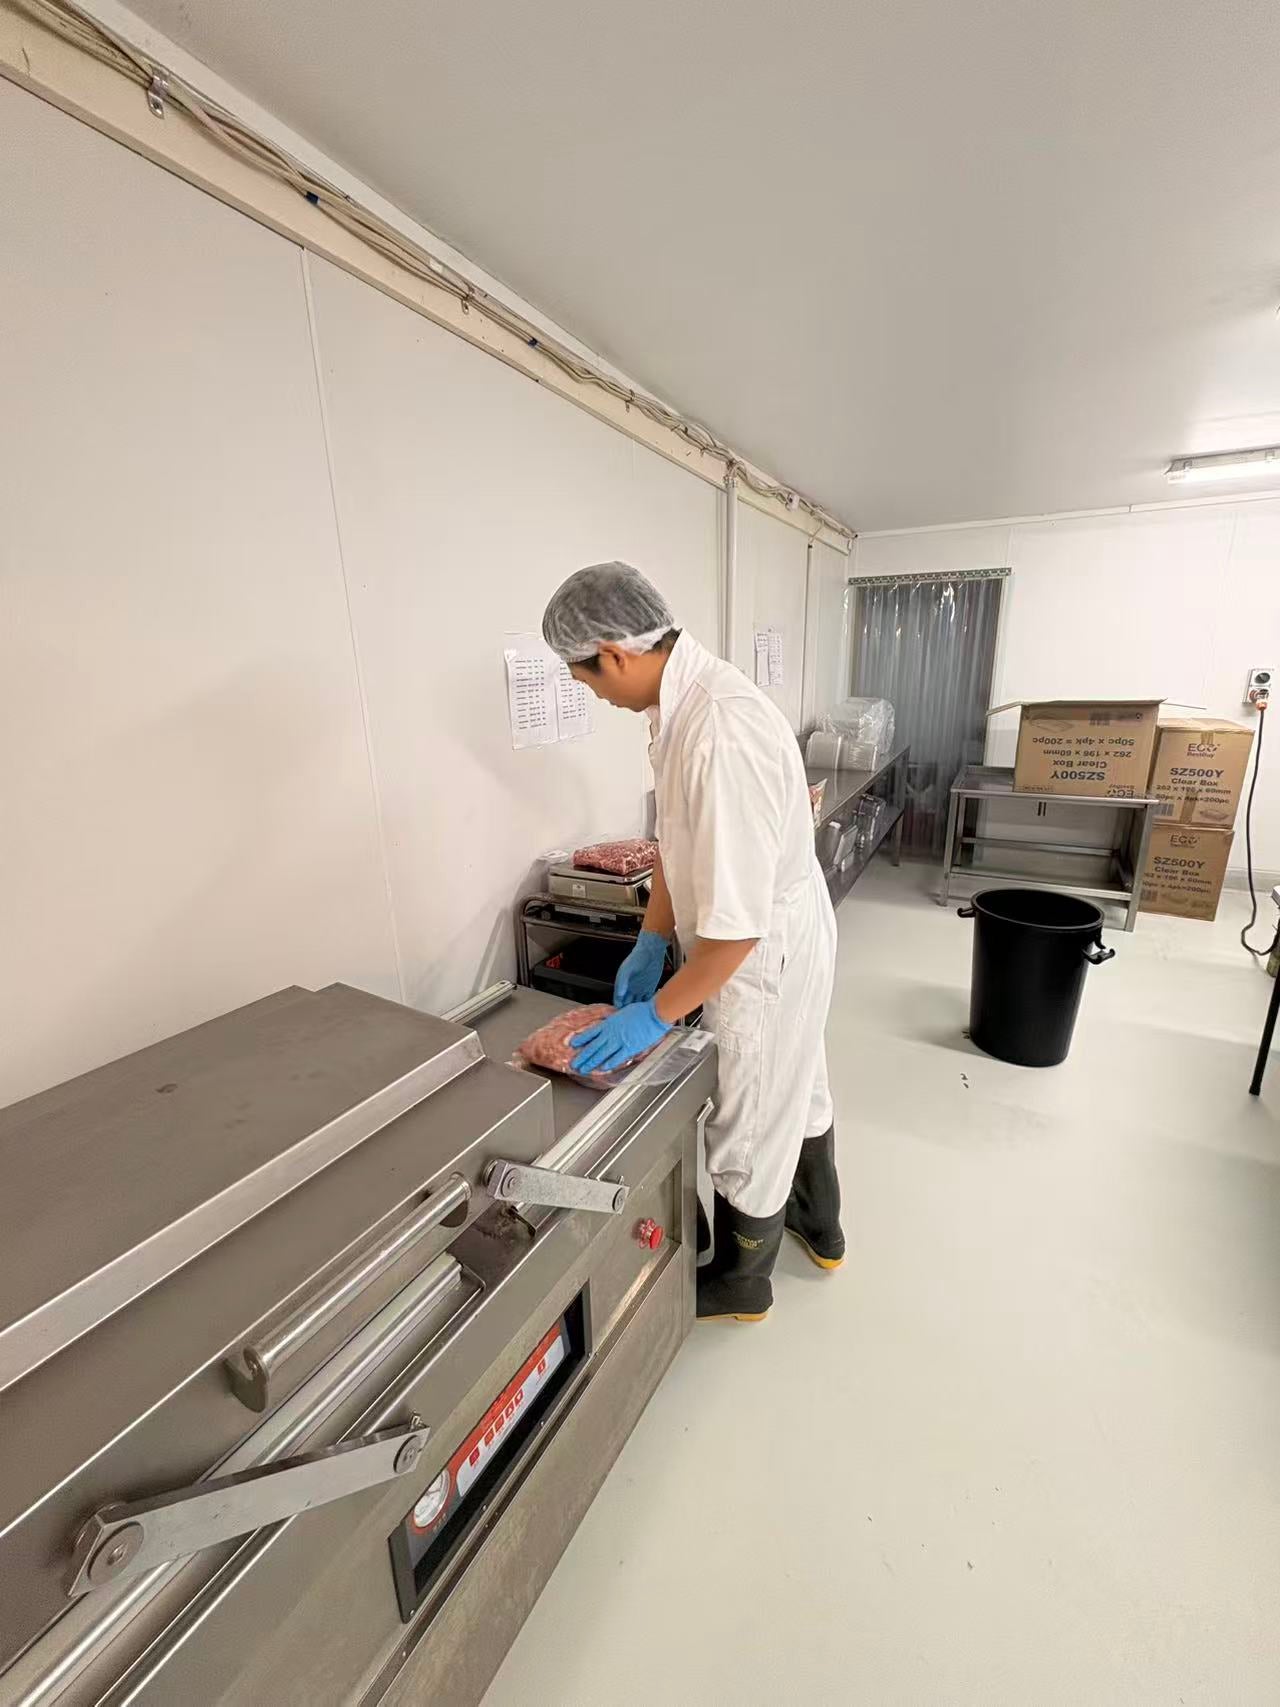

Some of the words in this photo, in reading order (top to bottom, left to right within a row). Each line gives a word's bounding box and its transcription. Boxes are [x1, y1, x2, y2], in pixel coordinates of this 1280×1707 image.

[1032, 736, 1063, 745] 200pc
[1075, 737, 1095, 746] 4pk
[1108, 737, 1135, 746] 50pc
[1076, 760, 1107, 768] Clear
[1050, 770, 1105, 781] SZ500Y
[1170, 767, 1224, 778] SZ500Y
[1153, 856, 1205, 869] SZ500Y
[1154, 866, 1179, 874] Clear
